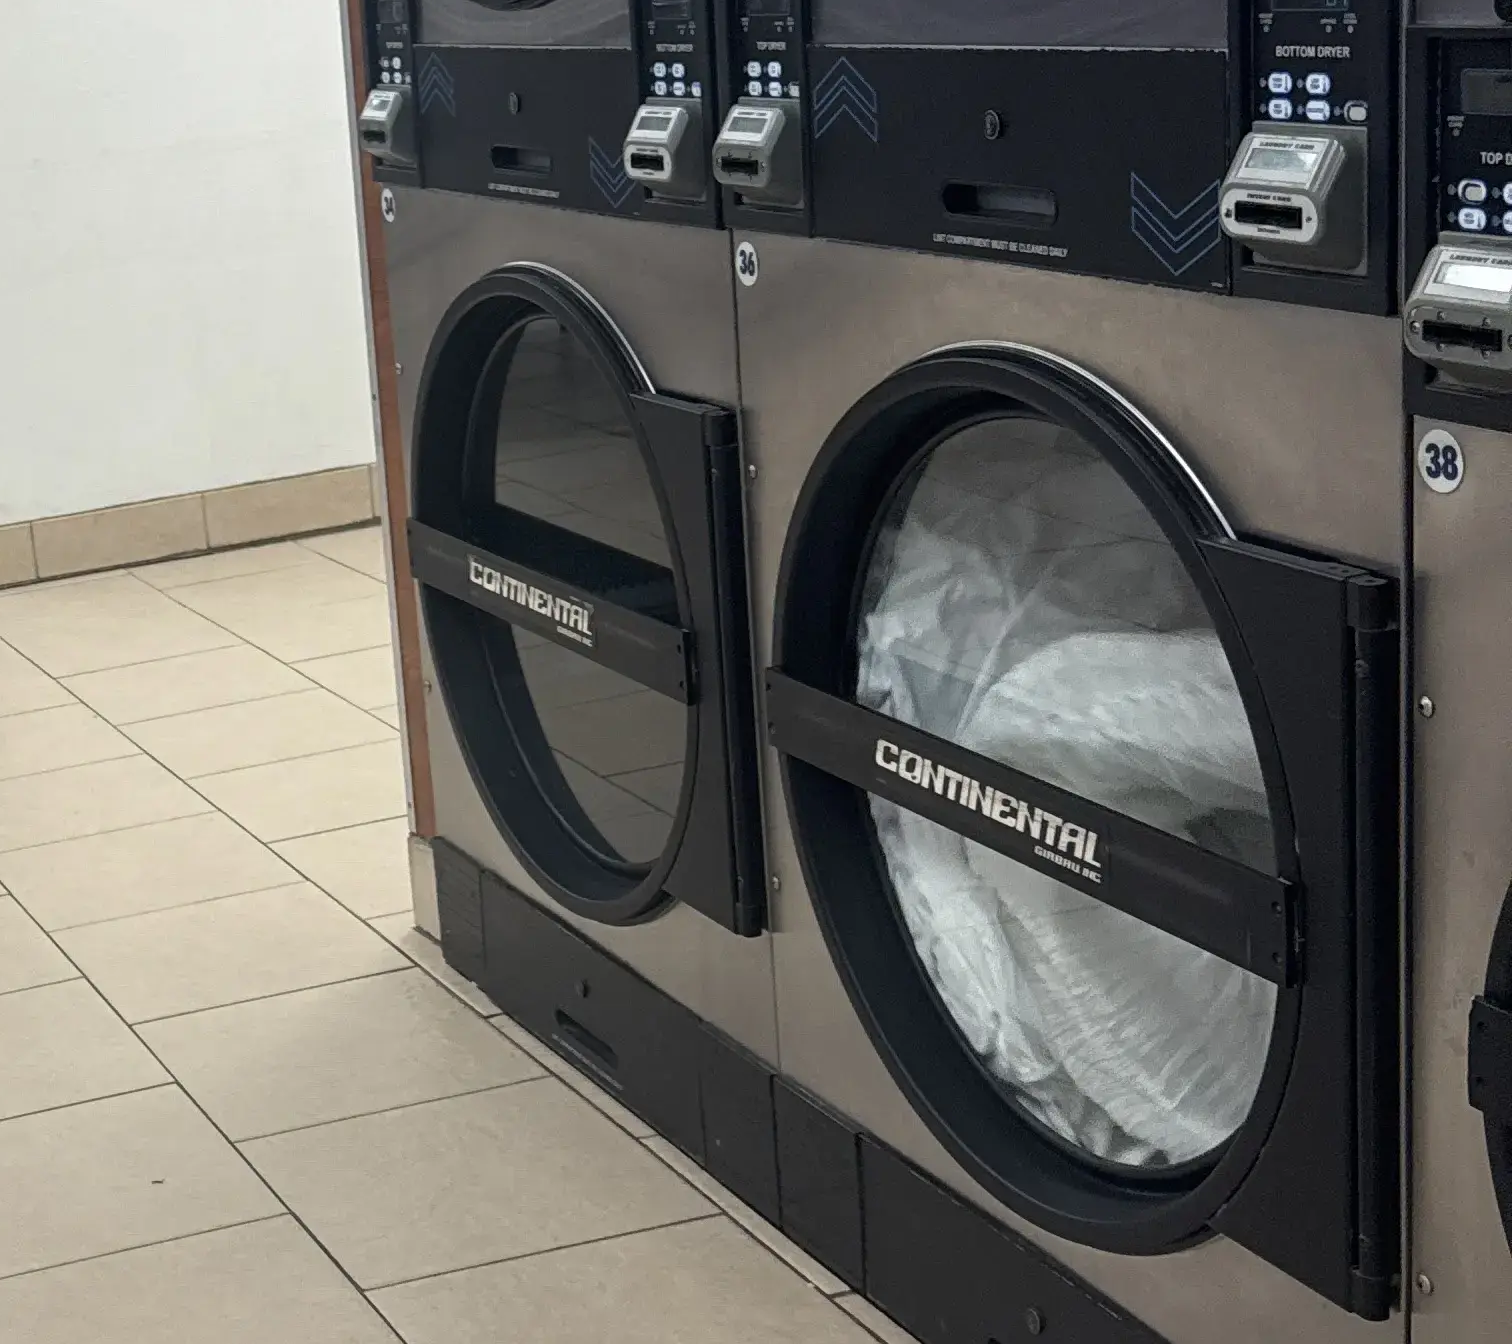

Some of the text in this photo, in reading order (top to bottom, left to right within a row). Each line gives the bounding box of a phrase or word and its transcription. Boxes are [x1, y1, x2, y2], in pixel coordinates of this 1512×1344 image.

[1275, 46, 1351, 58] BOTTOM DRYER
[1480, 152, 1504, 164] TOP
[384, 196, 394, 216] 34
[739, 250, 755, 276] 36
[1425, 443, 1458, 481] 38
[470, 561, 592, 636] CONTINENTAL
[875, 739, 1102, 868] CONTINENTAL
[1034, 845, 1081, 876] GIRBAU
